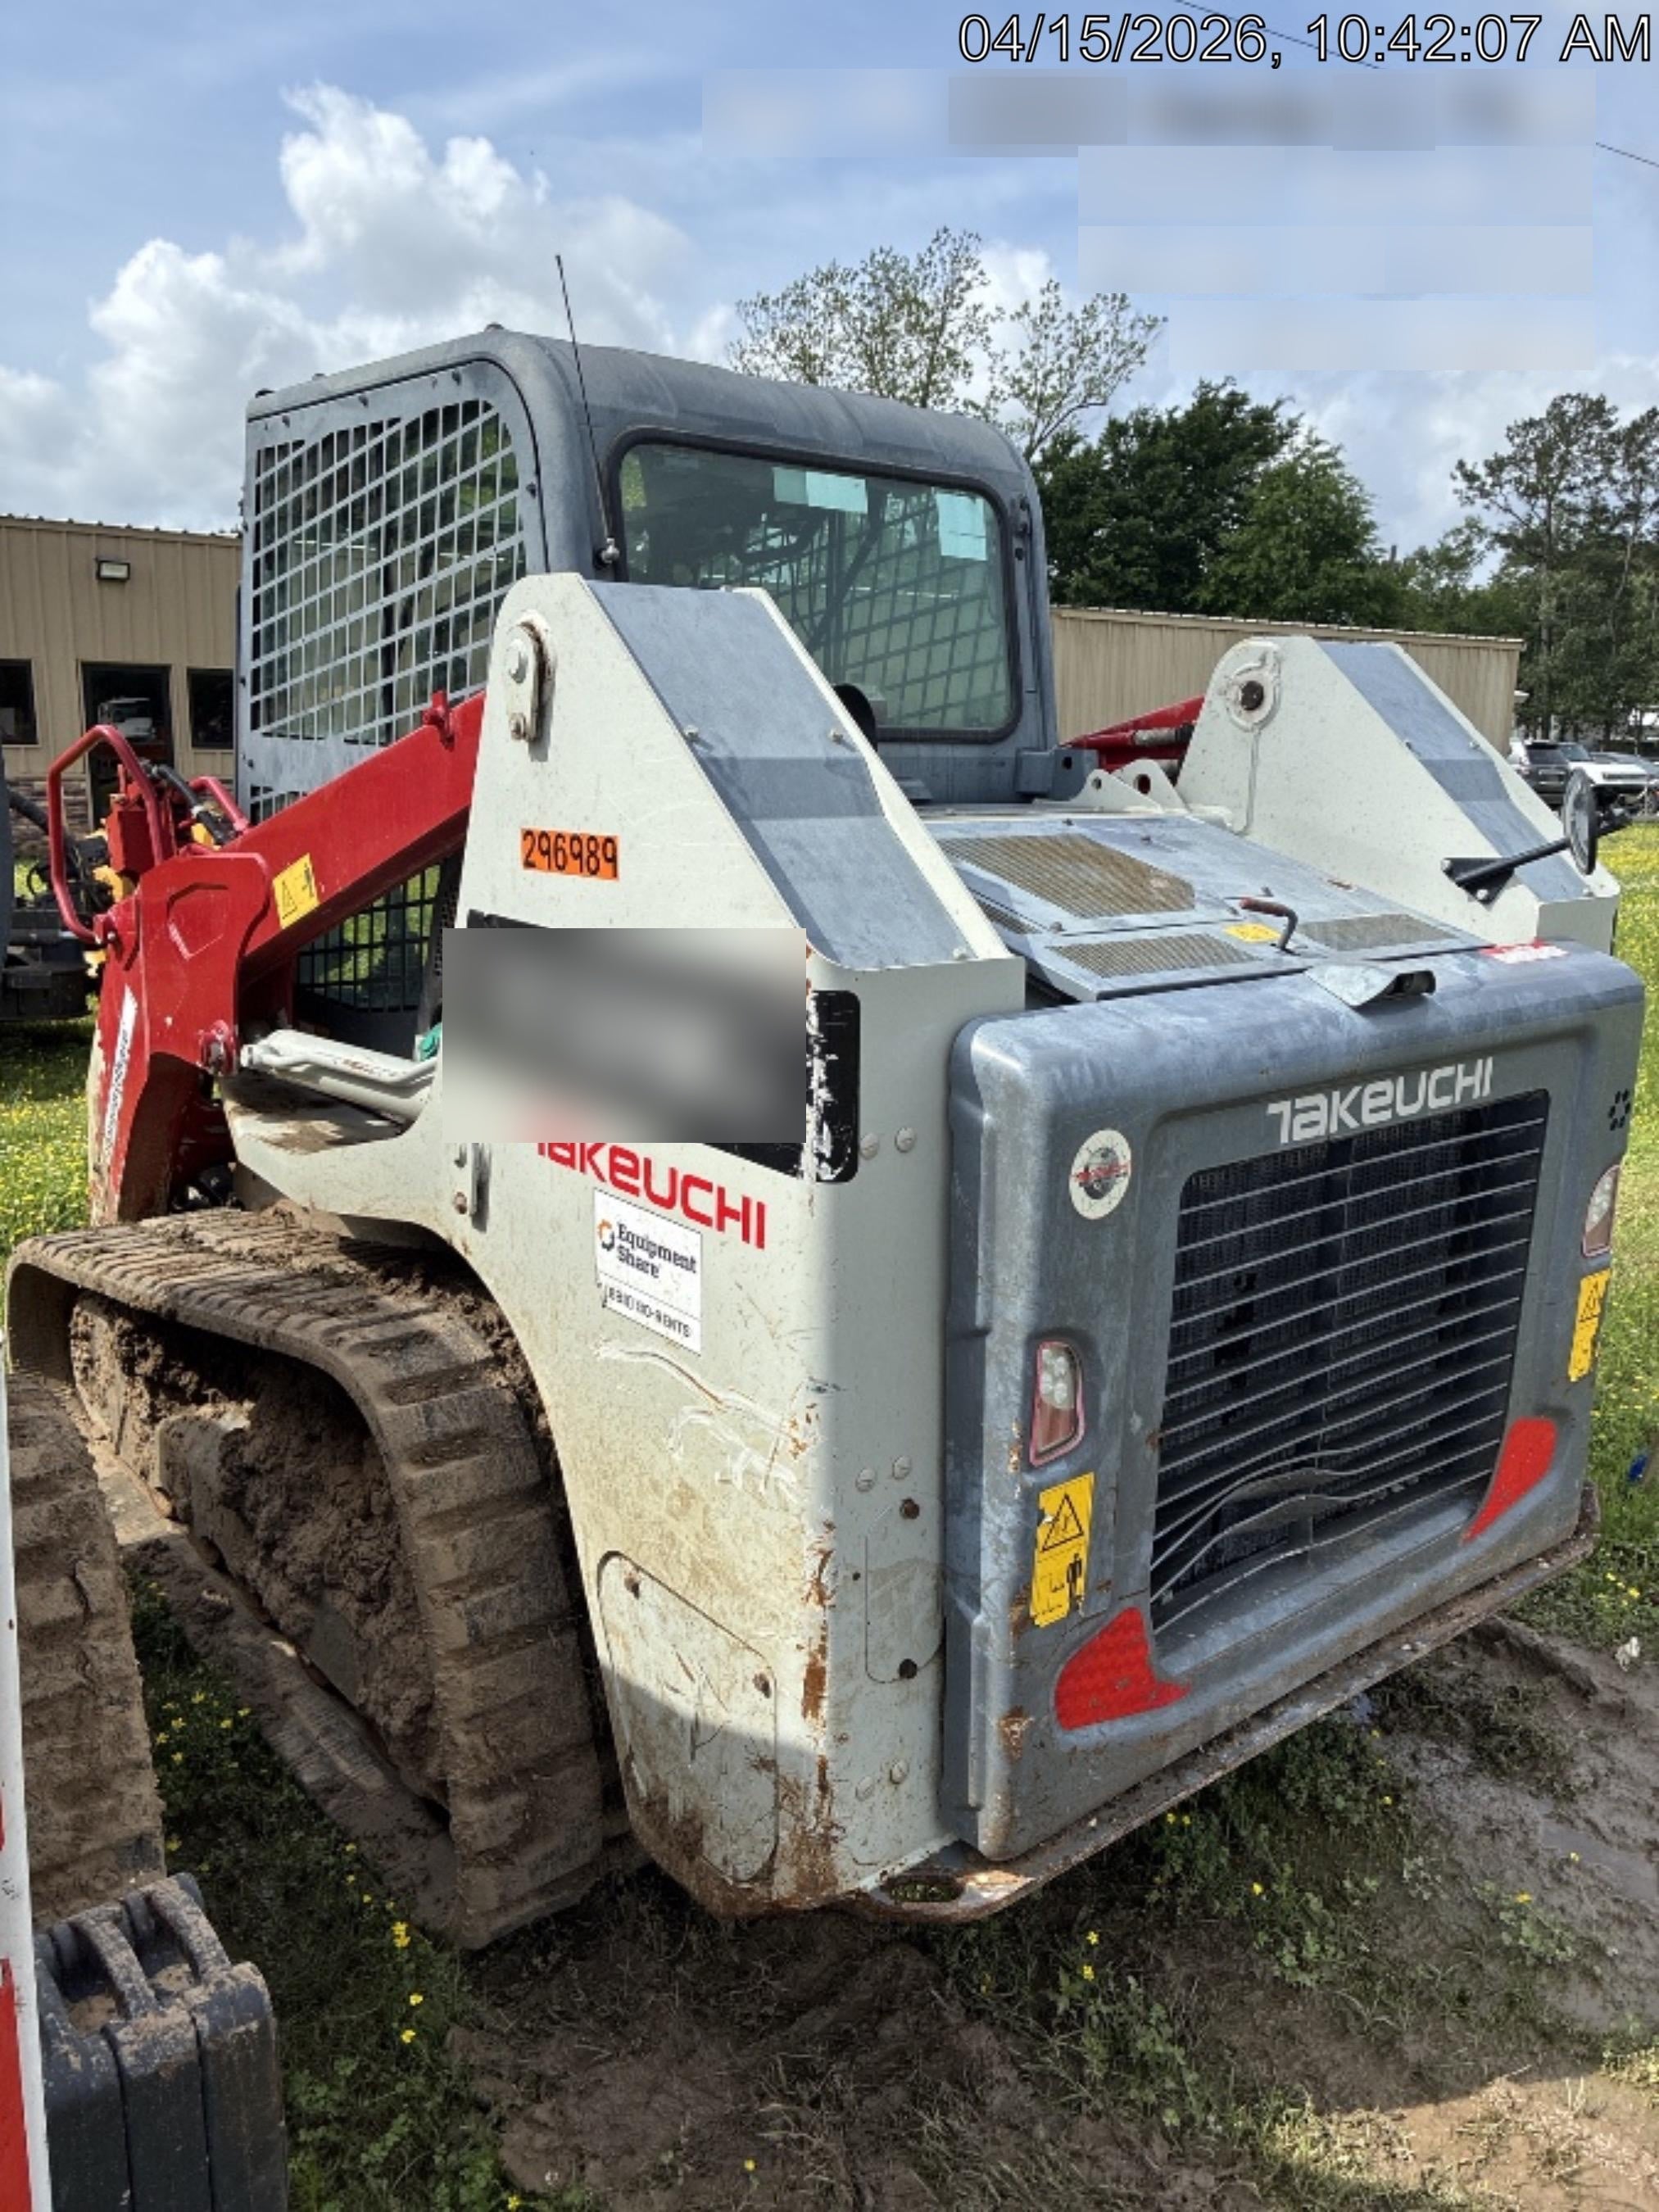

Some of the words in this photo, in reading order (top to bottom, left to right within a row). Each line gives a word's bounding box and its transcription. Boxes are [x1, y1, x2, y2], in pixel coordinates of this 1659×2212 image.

[522, 829, 618, 878] 296989
[617, 1222, 696, 1274] Equipment
[617, 1244, 660, 1279] Share
